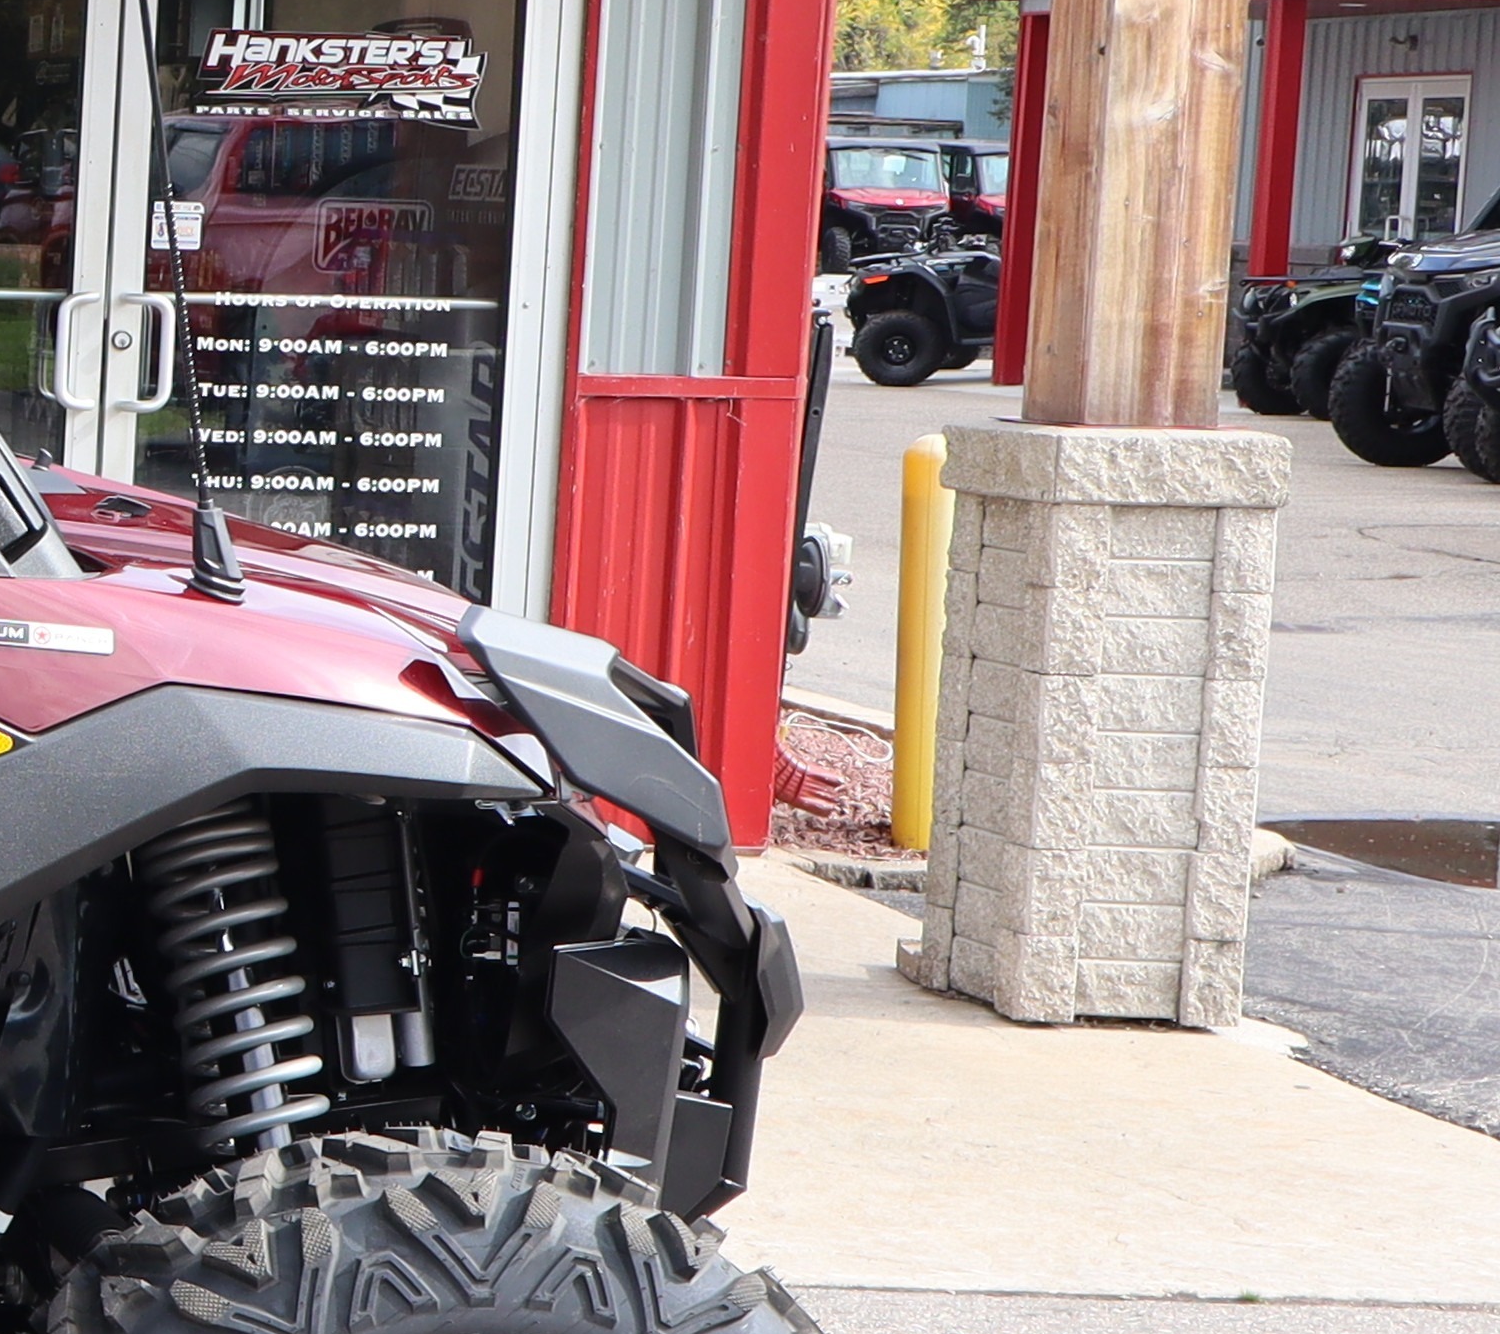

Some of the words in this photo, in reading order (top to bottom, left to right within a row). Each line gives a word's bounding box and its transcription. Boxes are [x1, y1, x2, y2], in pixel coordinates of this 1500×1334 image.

[195, 105, 270, 116] PARTS
[286, 107, 385, 118] SERVICE
[401, 109, 473, 120] SALES
[365, 341, 448, 358] 6:00PM
[255, 384, 340, 400] 9:00AM
[362, 386, 446, 403] 6:00PM
[253, 429, 337, 446] 9:00AM
[359, 431, 443, 448] 6:00PM
[250, 475, 335, 492] 9:00AM
[356, 477, 440, 494] 6:00PM
[354, 522, 437, 539] 6:00PM
